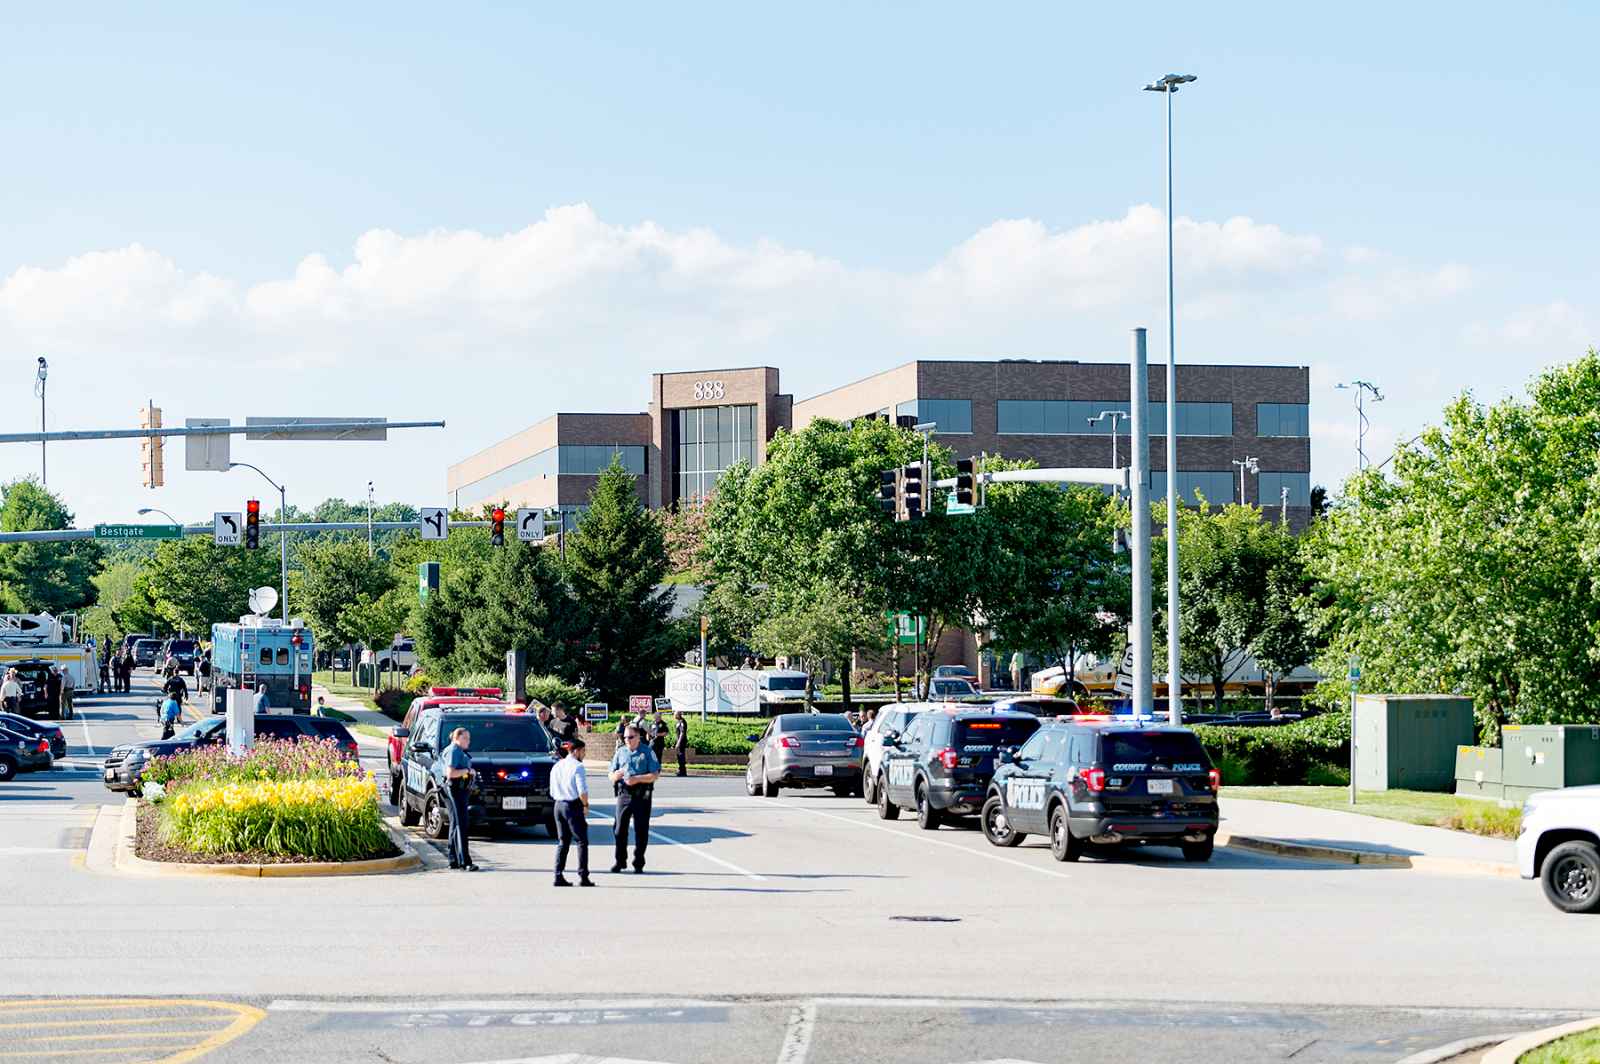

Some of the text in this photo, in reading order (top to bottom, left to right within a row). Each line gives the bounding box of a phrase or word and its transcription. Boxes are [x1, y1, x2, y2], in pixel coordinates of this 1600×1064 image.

[695, 381, 724, 400] 888
[100, 527, 144, 538] Bestgate
[217, 535, 239, 543] ONLY
[963, 744, 994, 752] COUNTY
[1113, 763, 1147, 771] COUNTY
[1172, 763, 1201, 771] POLICE
